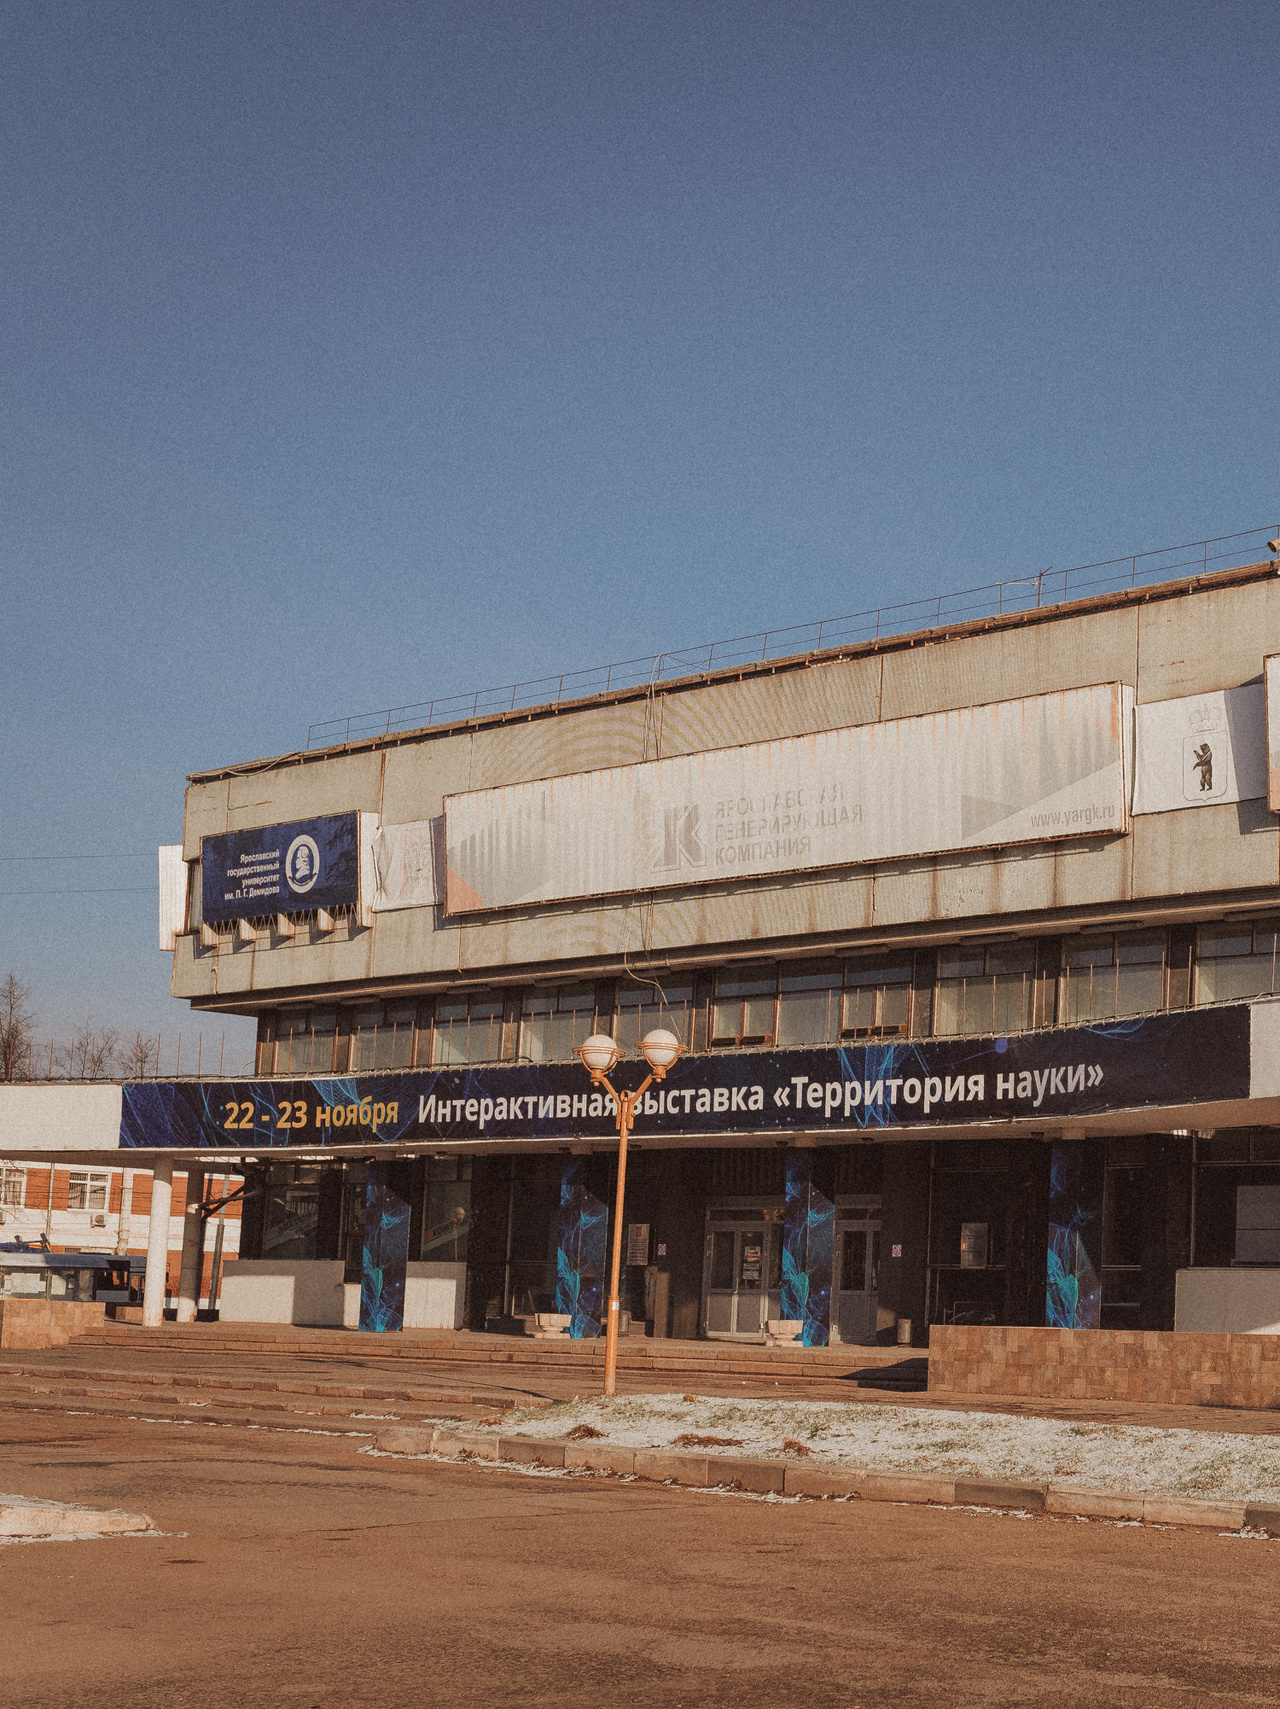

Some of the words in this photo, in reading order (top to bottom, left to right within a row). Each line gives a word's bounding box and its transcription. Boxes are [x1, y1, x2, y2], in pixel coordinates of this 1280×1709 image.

[715, 784, 844, 819] ЯРОАВСАЯ
[715, 804, 864, 842] ГЕНЕРИРУЮЩАЯ
[1030, 803, 1116, 828] www.yargk.ru
[240, 849, 279, 864] Ярославский
[715, 836, 812, 866] КОМПАНИЯ
[227, 861, 279, 877] государственный
[242, 874, 279, 888] университет
[249, 886, 279, 898] Демидова
[223, 1102, 255, 1129] 22
[276, 1100, 308, 1129] 23
[315, 1095, 399, 1133] ноября
[418, 1092, 617, 1130] Интерактивная
[631, 1083, 764, 1116] выставка
[774, 1072, 985, 1118] «Территория
[996, 1062, 1105, 1108] науки»
